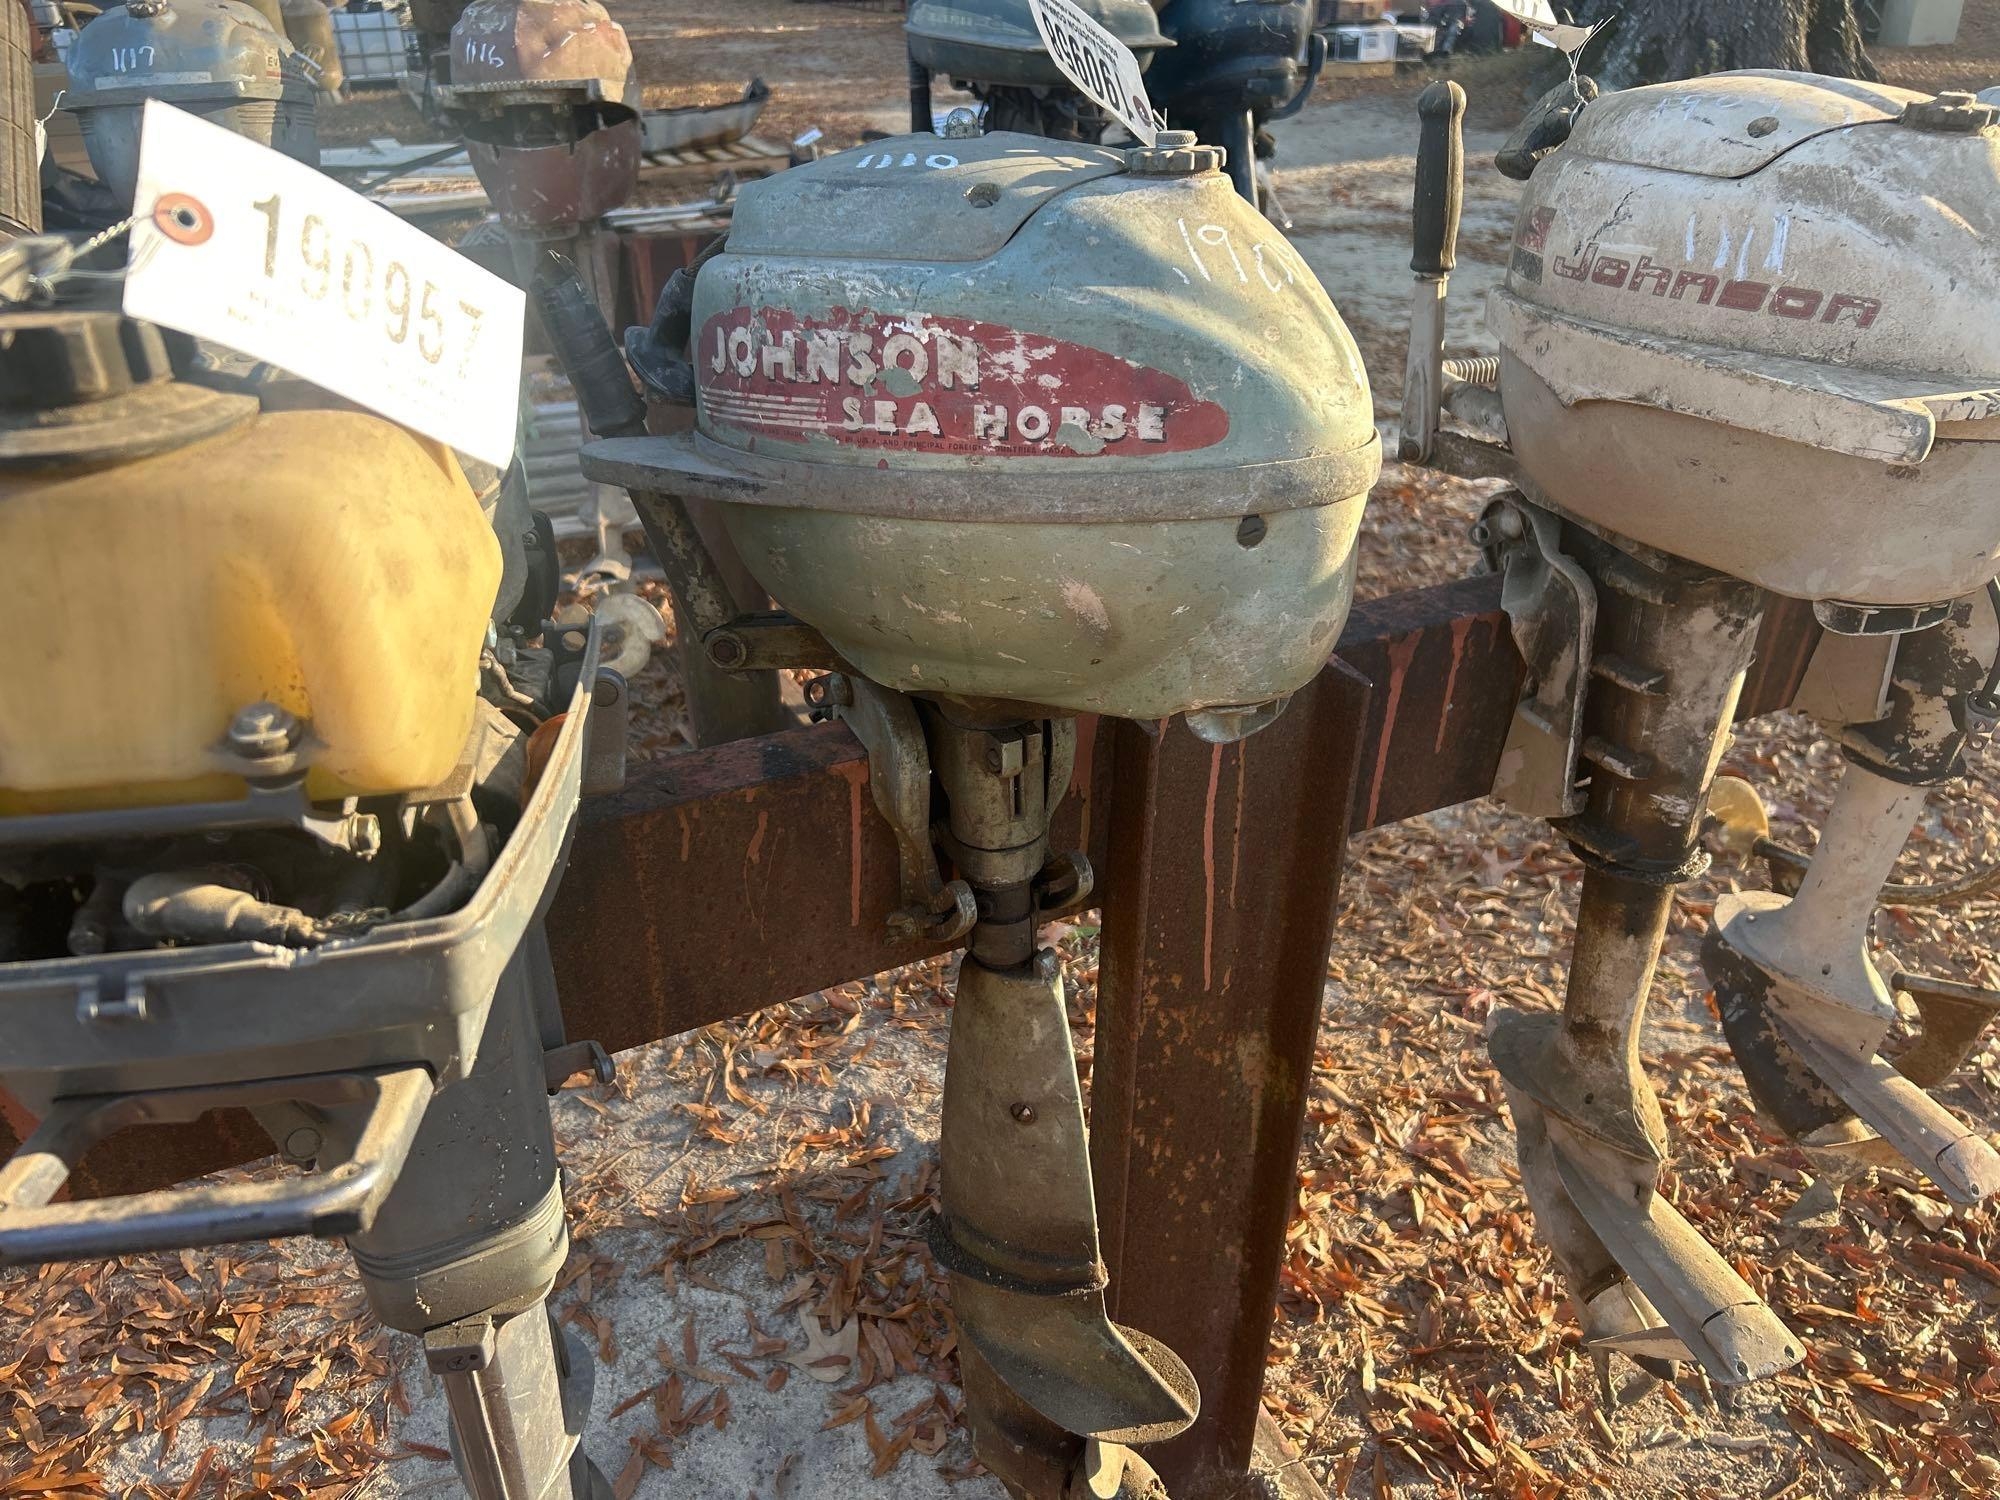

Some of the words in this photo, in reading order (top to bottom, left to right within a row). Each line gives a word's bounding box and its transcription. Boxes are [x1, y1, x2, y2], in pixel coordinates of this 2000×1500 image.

[112, 46, 154, 72] 1117
[1041, 12, 1134, 122] 190958
[856, 153, 959, 169] 1110
[253, 193, 485, 380] 190957
[1552, 242, 1883, 329] Johnson
[711, 325, 981, 391] JOHNSON
[842, 396, 944, 438] SEA
